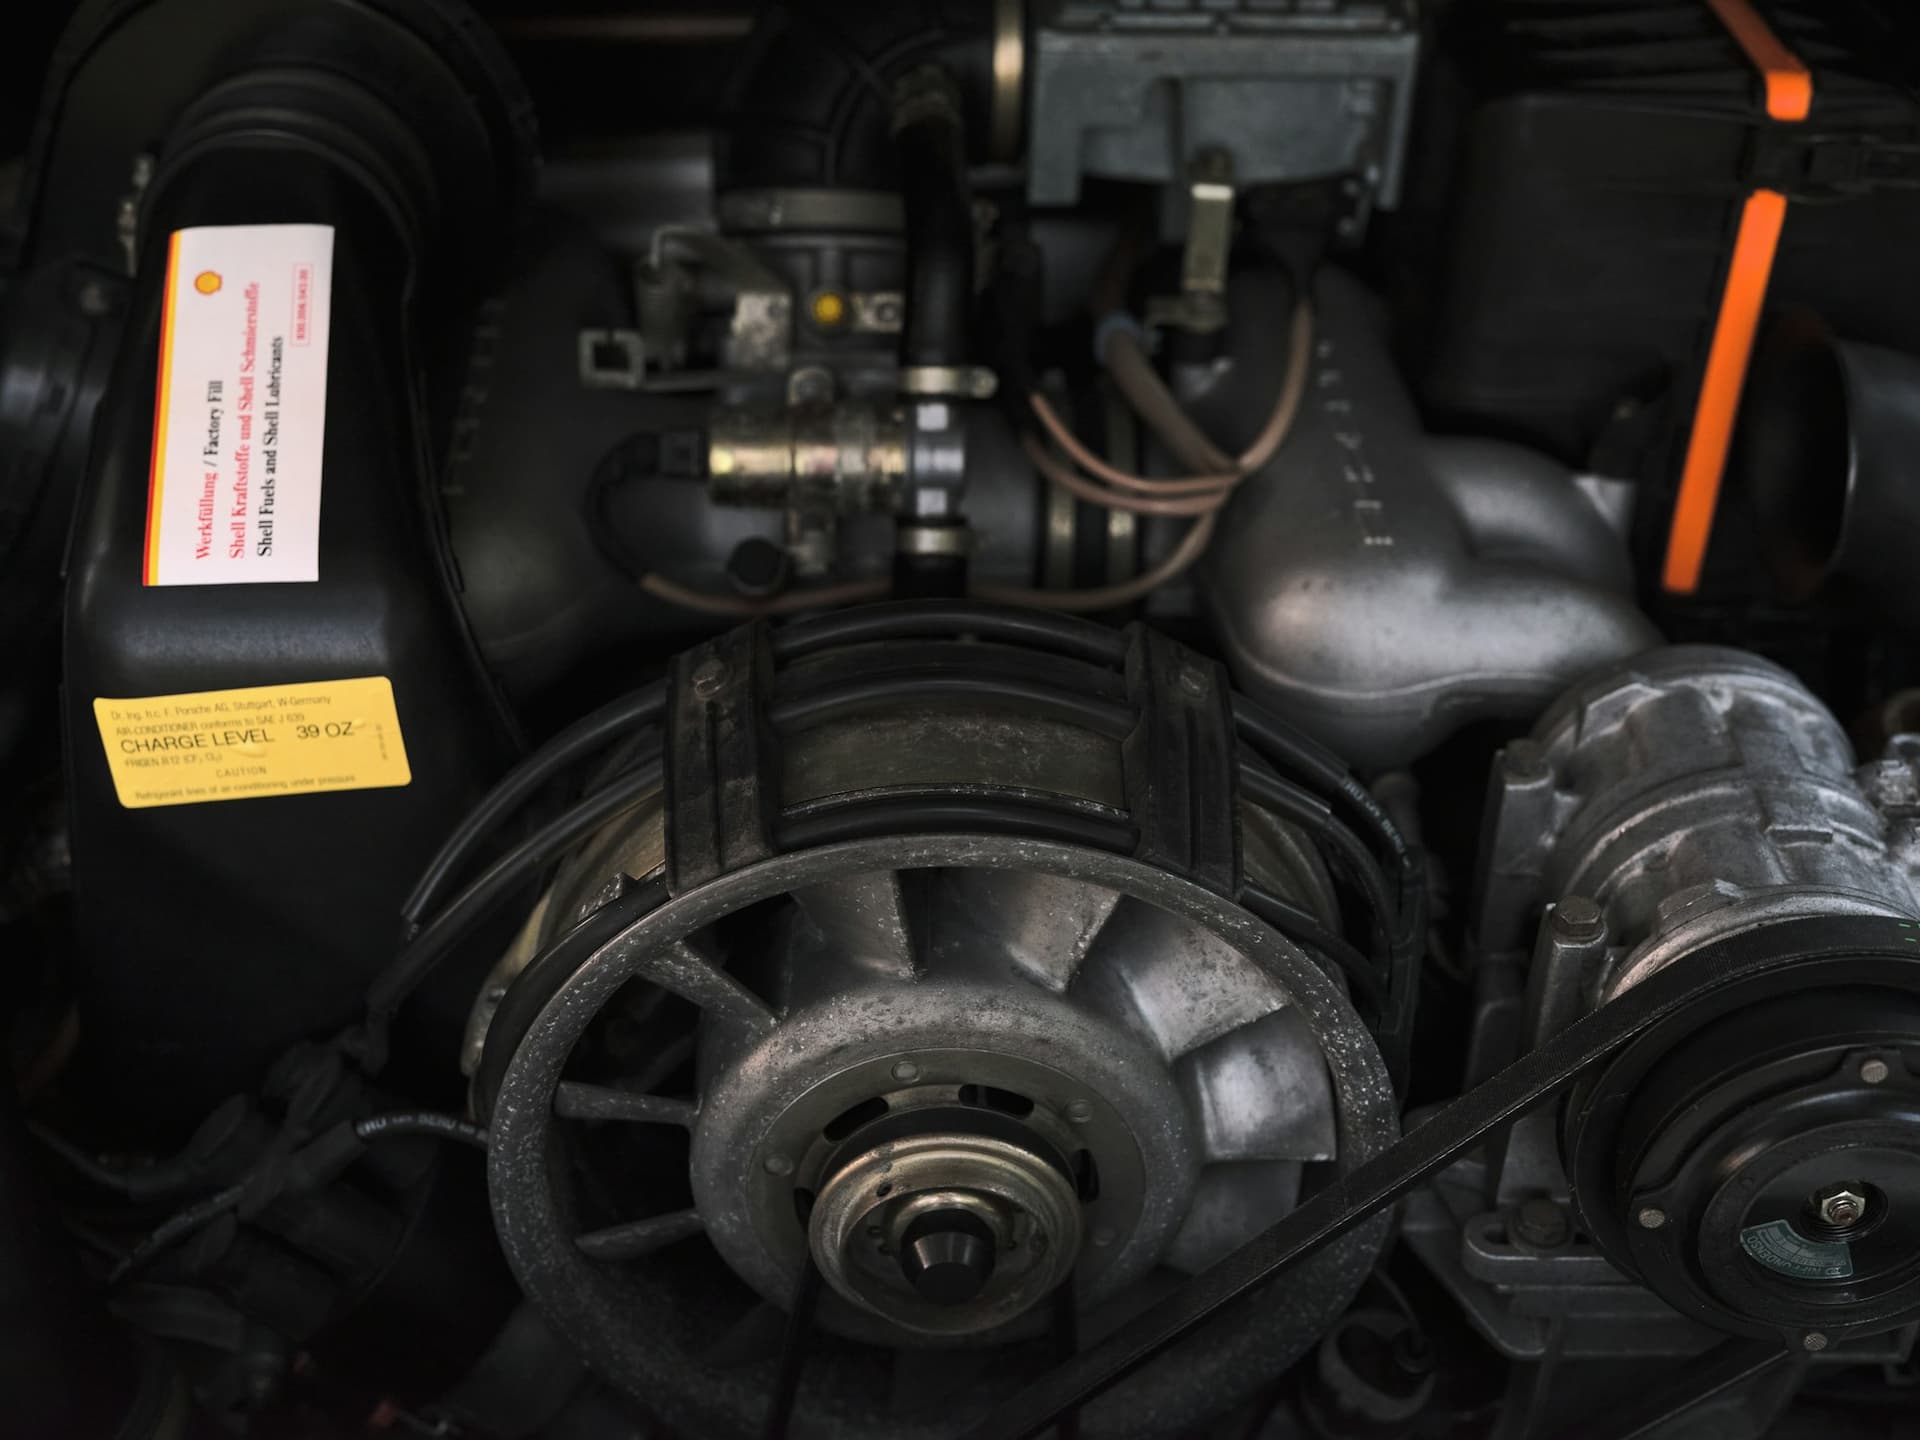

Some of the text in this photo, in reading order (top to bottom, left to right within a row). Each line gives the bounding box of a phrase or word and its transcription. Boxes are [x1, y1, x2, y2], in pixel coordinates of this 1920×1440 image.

[206, 380, 224, 403] Fill
[202, 409, 225, 456] Factory
[228, 281, 260, 560] Shell Kraftstoffe und Shell Schmierstoffe
[256, 336, 283, 557] Shell Fuels and Shell Lubricants
[195, 472, 218, 560] Werkfüllung
[120, 721, 355, 754] CHARGE LEVEL 39 OZ
[215, 765, 267, 778] CAUTION
